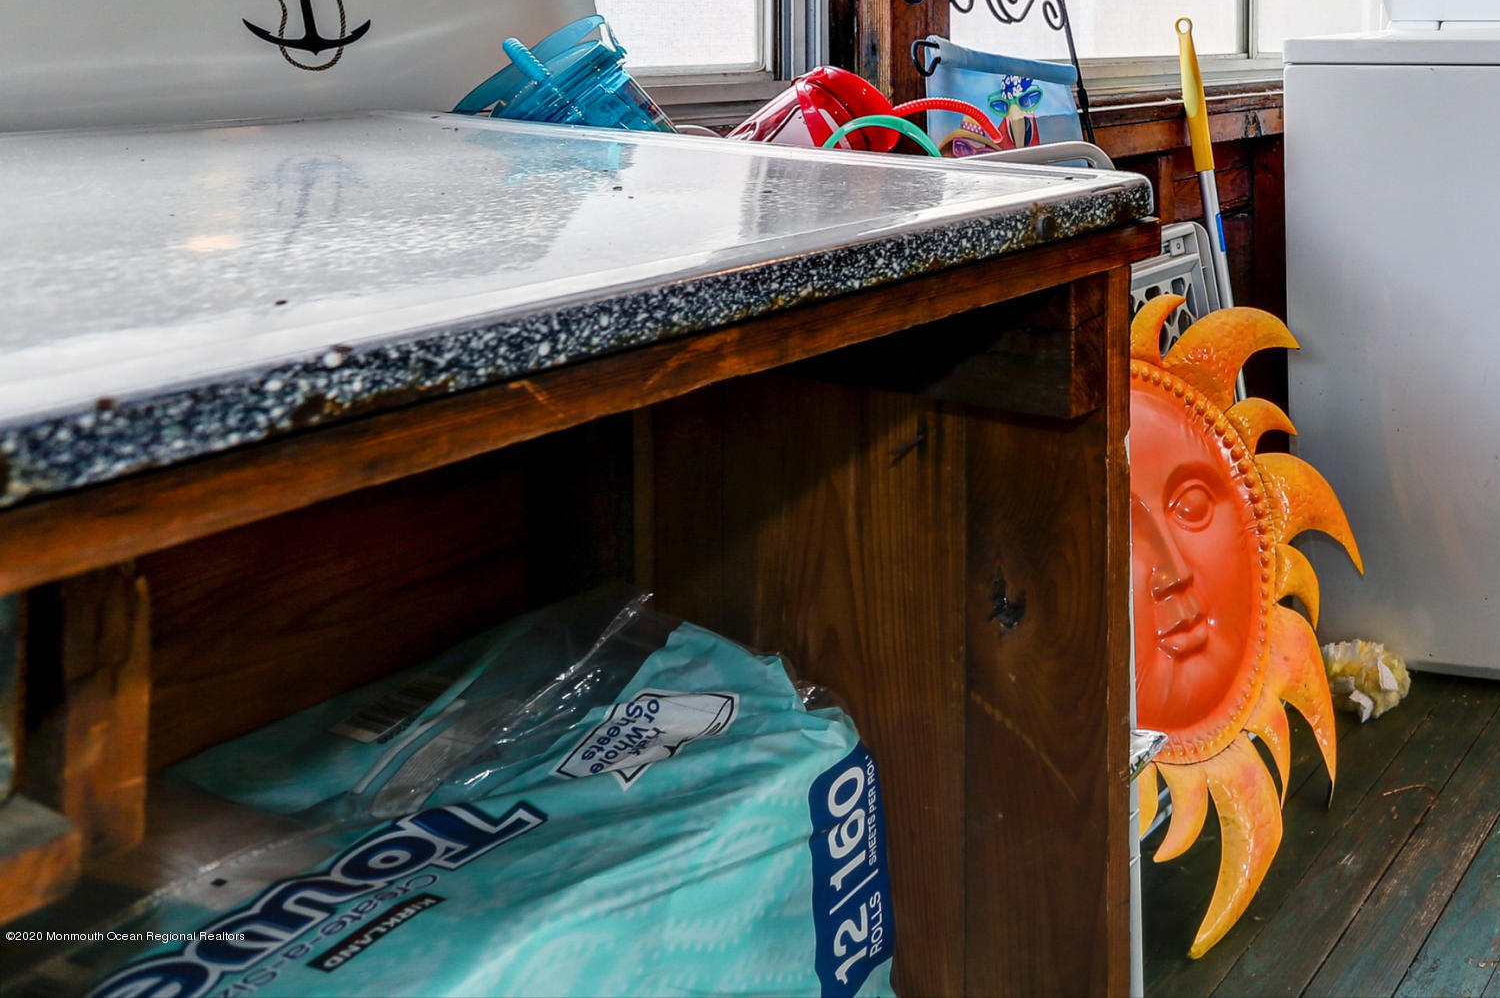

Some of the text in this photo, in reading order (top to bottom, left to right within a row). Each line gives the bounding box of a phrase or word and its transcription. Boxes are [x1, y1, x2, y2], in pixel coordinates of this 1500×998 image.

[581, 702, 644, 761] Sheets
[590, 699, 660, 774] or Whole
[867, 784, 876, 813] PER
[867, 814, 877, 866] SHEETS
[321, 897, 438, 969] KIRKLAND
[869, 891, 883, 958] ROLLS
